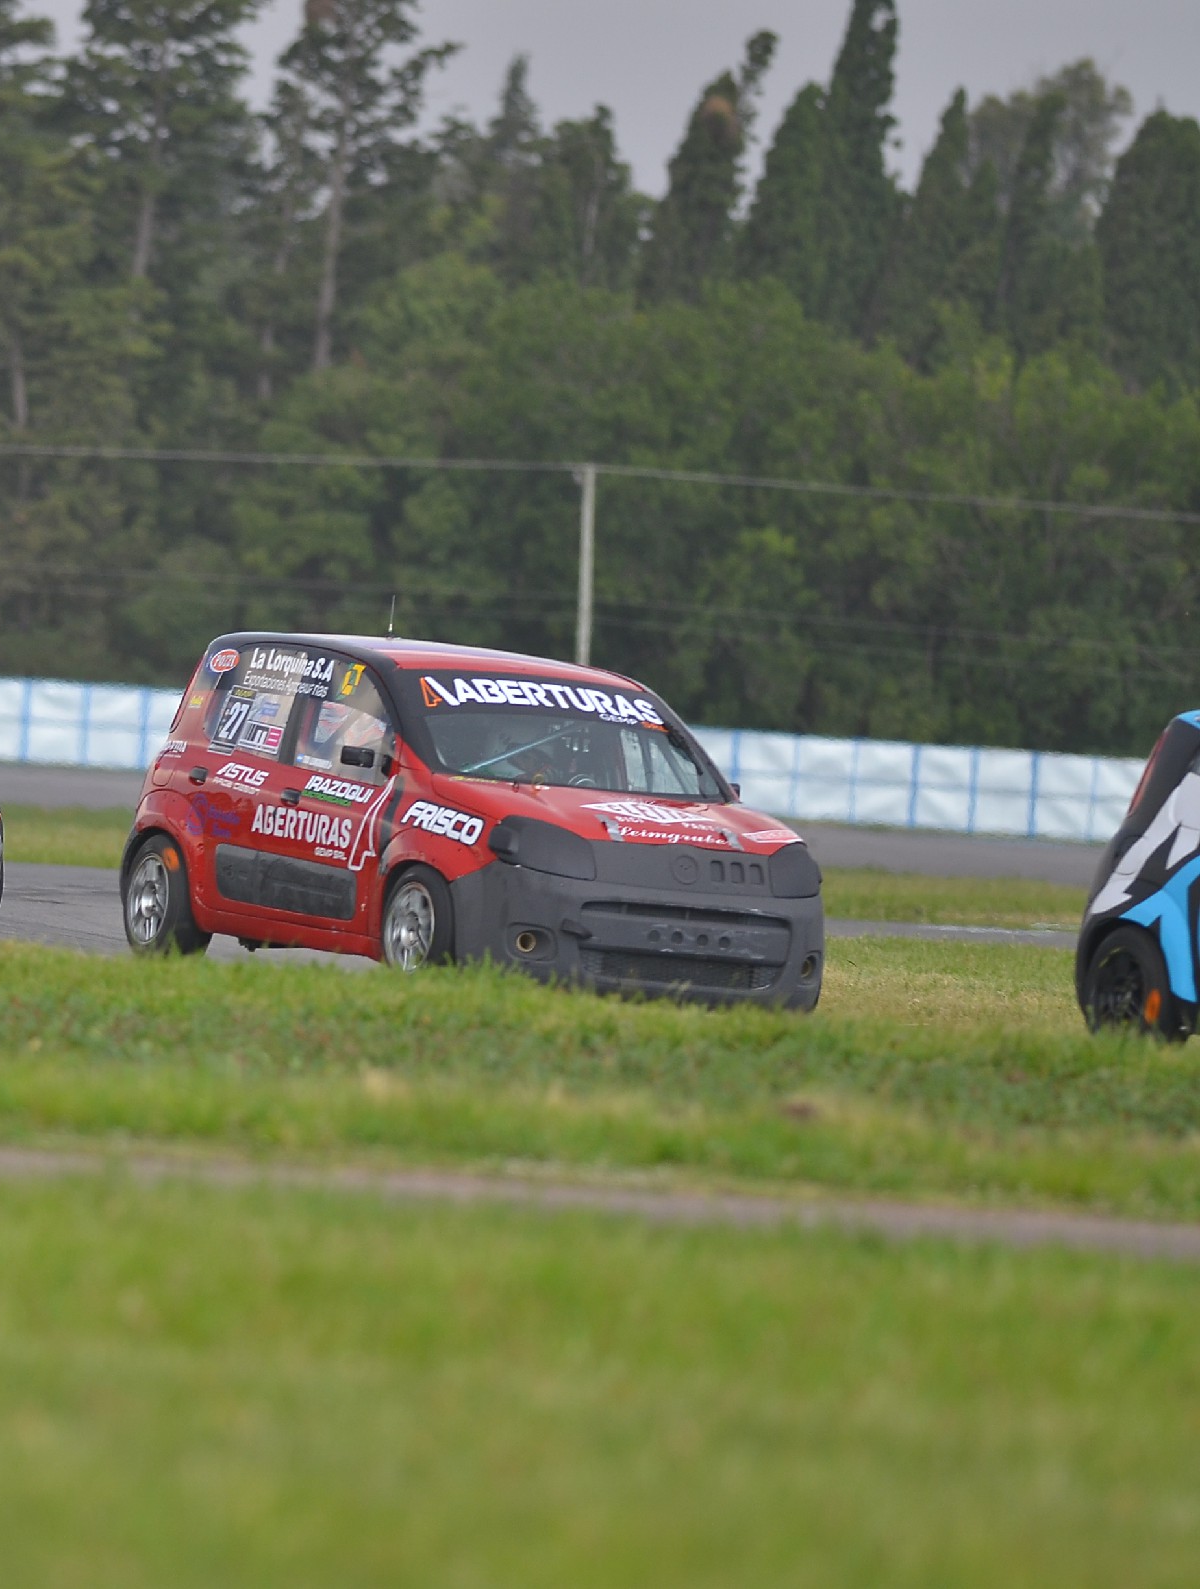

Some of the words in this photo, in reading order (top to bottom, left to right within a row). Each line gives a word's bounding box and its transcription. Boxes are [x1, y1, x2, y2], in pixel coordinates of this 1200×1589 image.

[250, 647, 267, 669] La
[453, 678, 665, 725] ABERTURAS
[216, 762, 270, 786] ASTUS
[304, 774, 375, 803] IRAZOQUI
[401, 801, 485, 846] FRISCO
